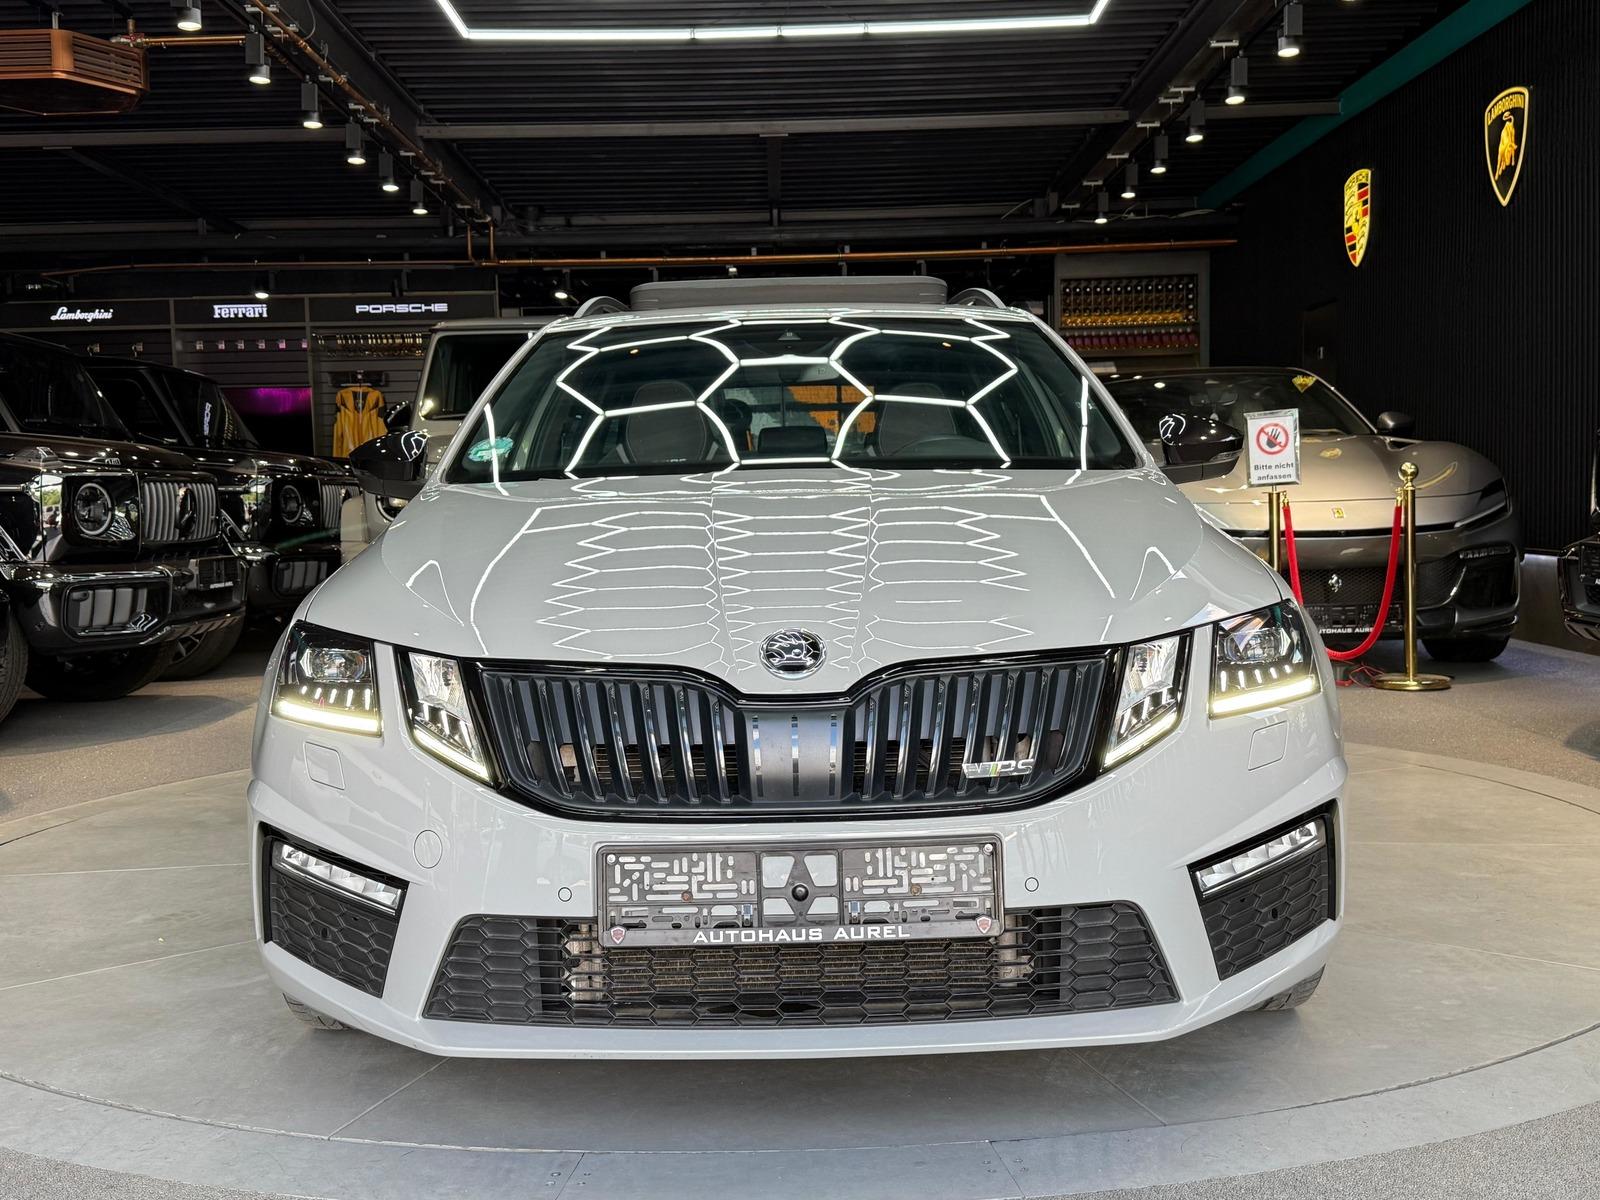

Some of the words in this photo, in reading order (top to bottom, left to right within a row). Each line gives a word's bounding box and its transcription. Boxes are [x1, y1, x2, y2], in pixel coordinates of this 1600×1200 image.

[50, 306, 114, 323] Lamborghini
[213, 304, 268, 319] Ferrari
[355, 303, 449, 314] PORSCHE
[1254, 463, 1273, 471] Bitte
[1257, 473, 1292, 481] anfassen
[692, 928, 823, 944] AUTOHAUS
[833, 925, 911, 940] AUREL
